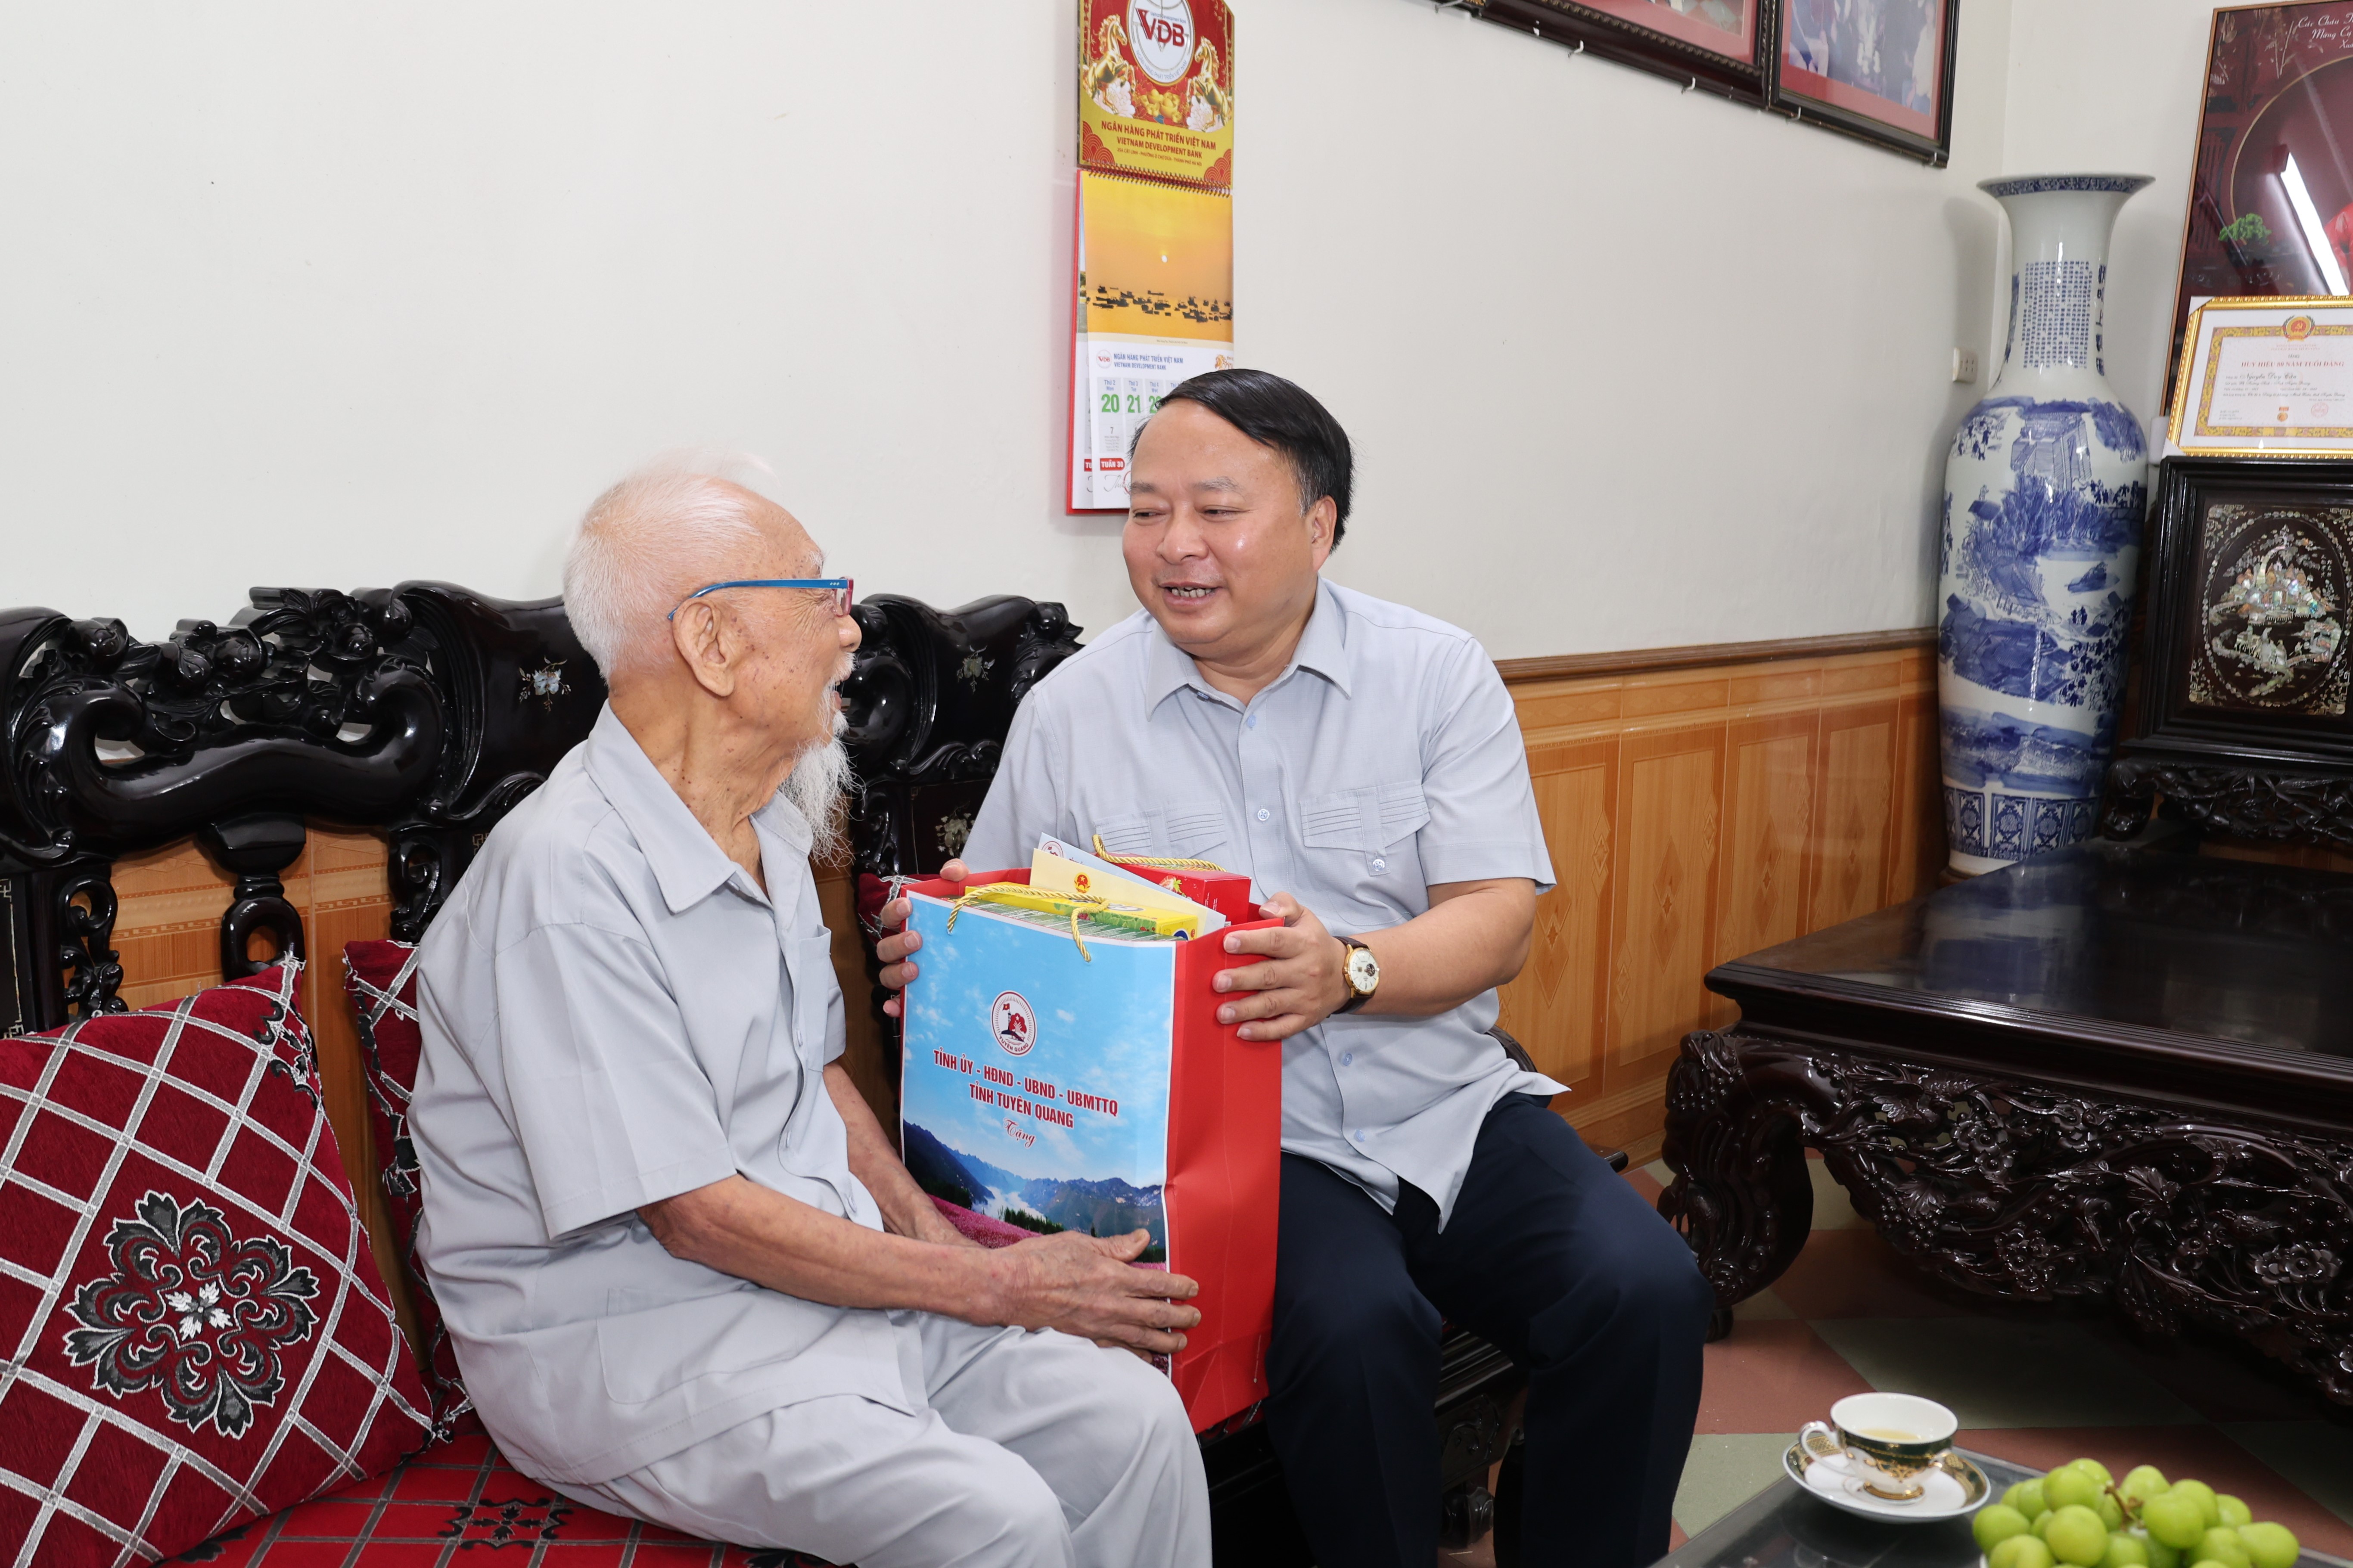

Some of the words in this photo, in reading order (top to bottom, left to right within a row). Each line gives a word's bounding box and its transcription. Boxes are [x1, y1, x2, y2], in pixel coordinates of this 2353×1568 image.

[1135, 8, 1184, 47] VDB
[1101, 121, 1122, 133] NGÂN
[1124, 124, 1144, 137] HÀNG
[1146, 129, 1164, 140] PHÁT
[1165, 132, 1184, 144] TRIỂN
[1185, 136, 1200, 149] VIỆT
[1201, 140, 1216, 150] NAM
[1117, 137, 1144, 148] VIETNAM
[1145, 141, 1186, 155] DEVELOPMENT
[1187, 149, 1202, 159] BANK
[1127, 353, 1138, 361] HÀNG
[1151, 354, 1163, 363] TRIỂN
[1164, 356, 1172, 364] VIỆT
[1101, 394, 1120, 413] 20
[1127, 394, 1141, 413] 21
[999, 1035, 1013, 1051] TUYÊN
[1014, 1043, 1029, 1052] QUANG
[934, 1047, 957, 1070] TỈNH
[960, 1054, 973, 1074] ỦY
[984, 1065, 1013, 1087] HĐND
[1025, 1077, 1055, 1099] UBND
[1067, 1090, 1118, 1117] UBMTTQ
[970, 1081, 993, 1104] TỈNH
[997, 1092, 1031, 1116] TUYÊN
[1035, 1104, 1073, 1128] QUANG
[1004, 1118, 1035, 1148] Tặng
